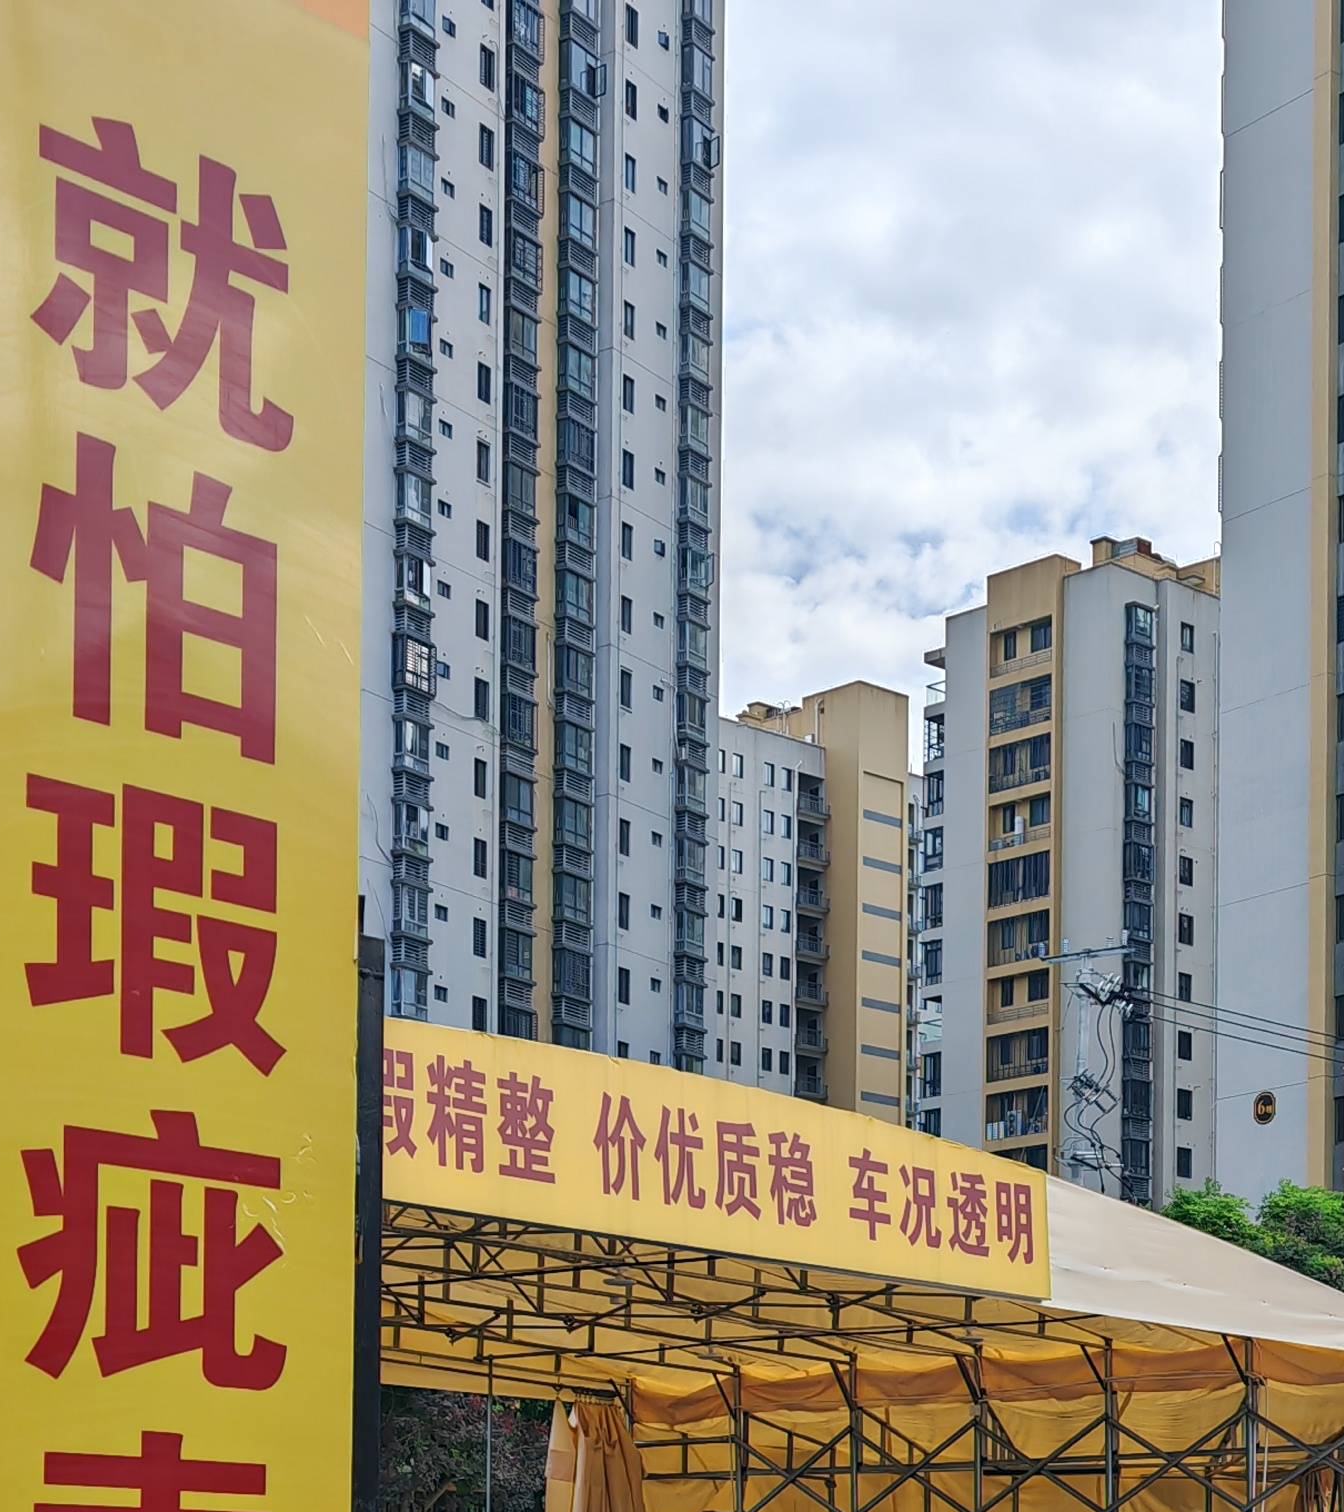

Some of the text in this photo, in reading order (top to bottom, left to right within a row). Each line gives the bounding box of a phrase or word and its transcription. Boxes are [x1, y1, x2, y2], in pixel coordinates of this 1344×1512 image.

[593, 1090, 820, 1227] 价优质稳
[847, 1146, 1035, 1266] 车况透明
